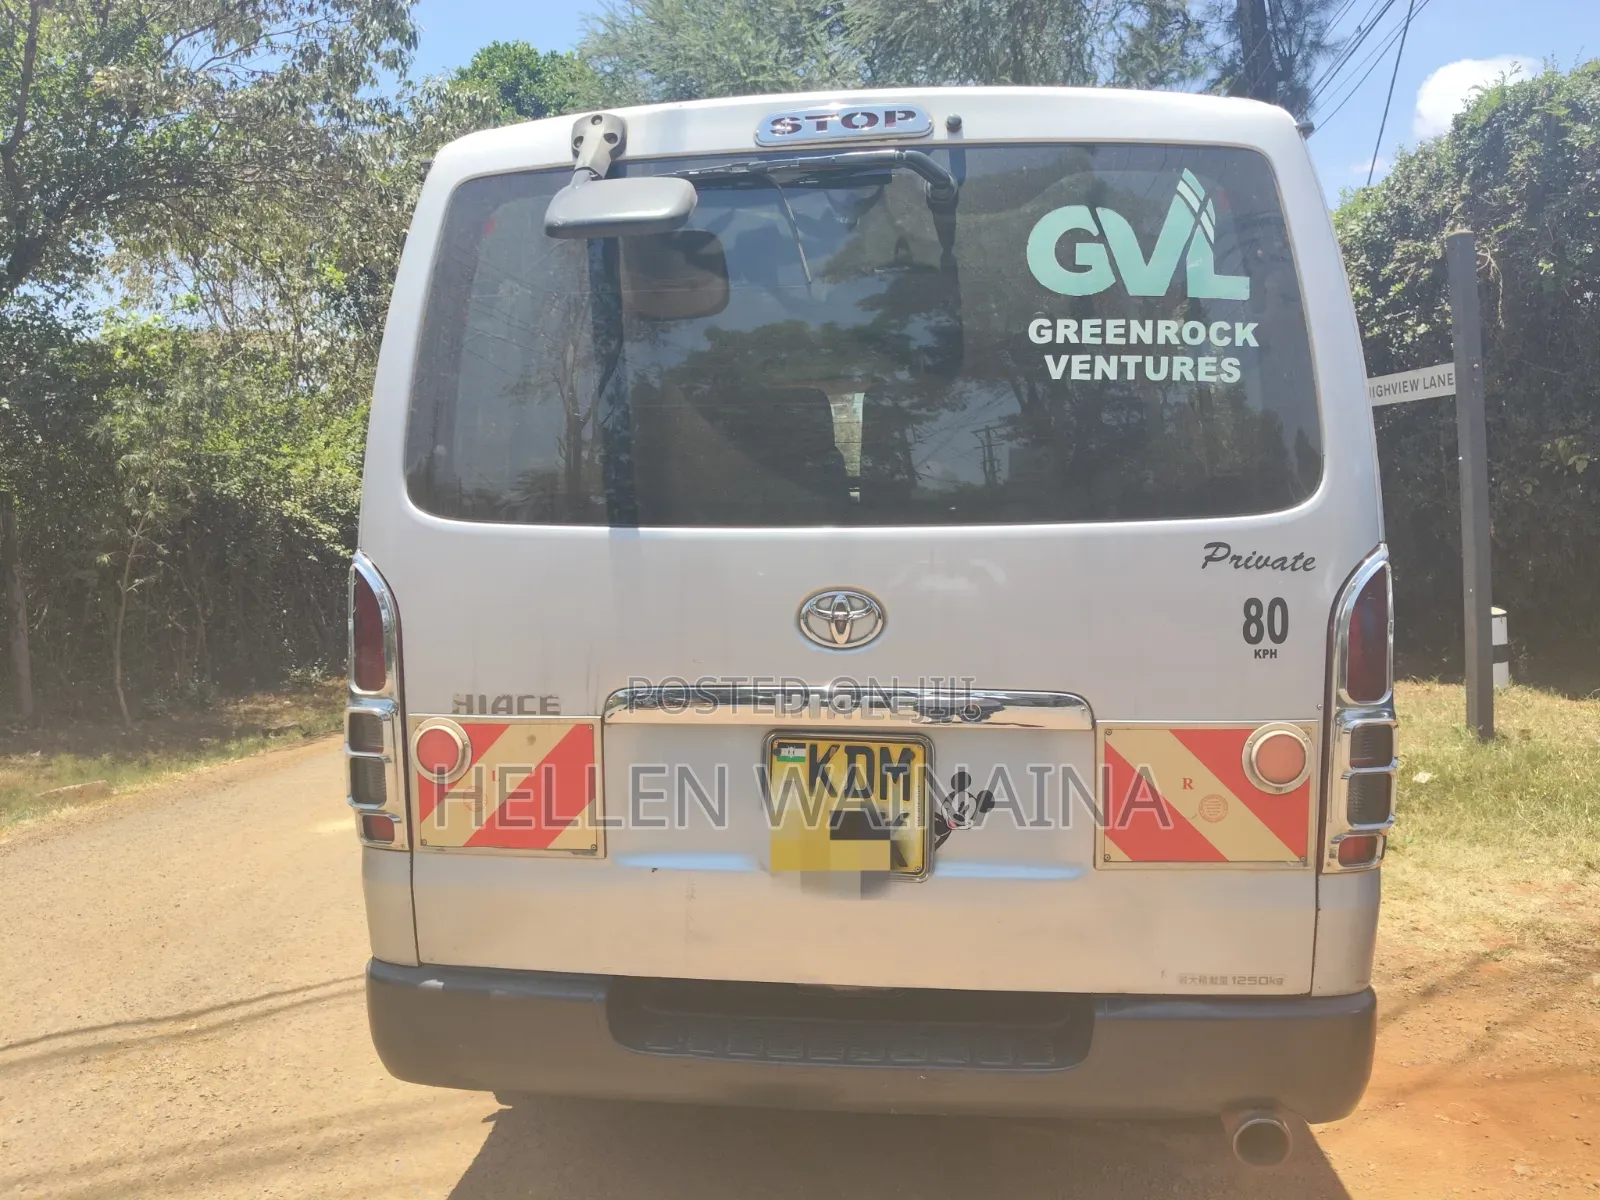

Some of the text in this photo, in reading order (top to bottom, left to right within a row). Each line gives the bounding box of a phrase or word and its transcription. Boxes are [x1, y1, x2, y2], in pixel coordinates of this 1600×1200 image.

[770, 110, 917, 136] STOP
[1026, 167, 1251, 300] GVL
[1028, 318, 1260, 348] GREENROCK
[1044, 354, 1242, 383] VENTURES
[1423, 373, 1455, 390] LANE
[1201, 541, 1316, 572] Private
[1242, 597, 1289, 645] 80
[1253, 649, 1278, 659] KPH
[451, 693, 561, 716] HIACE
[808, 742, 915, 802] KDM
[1181, 777, 1195, 790] R
[1231, 975, 1284, 986] 1250kg
